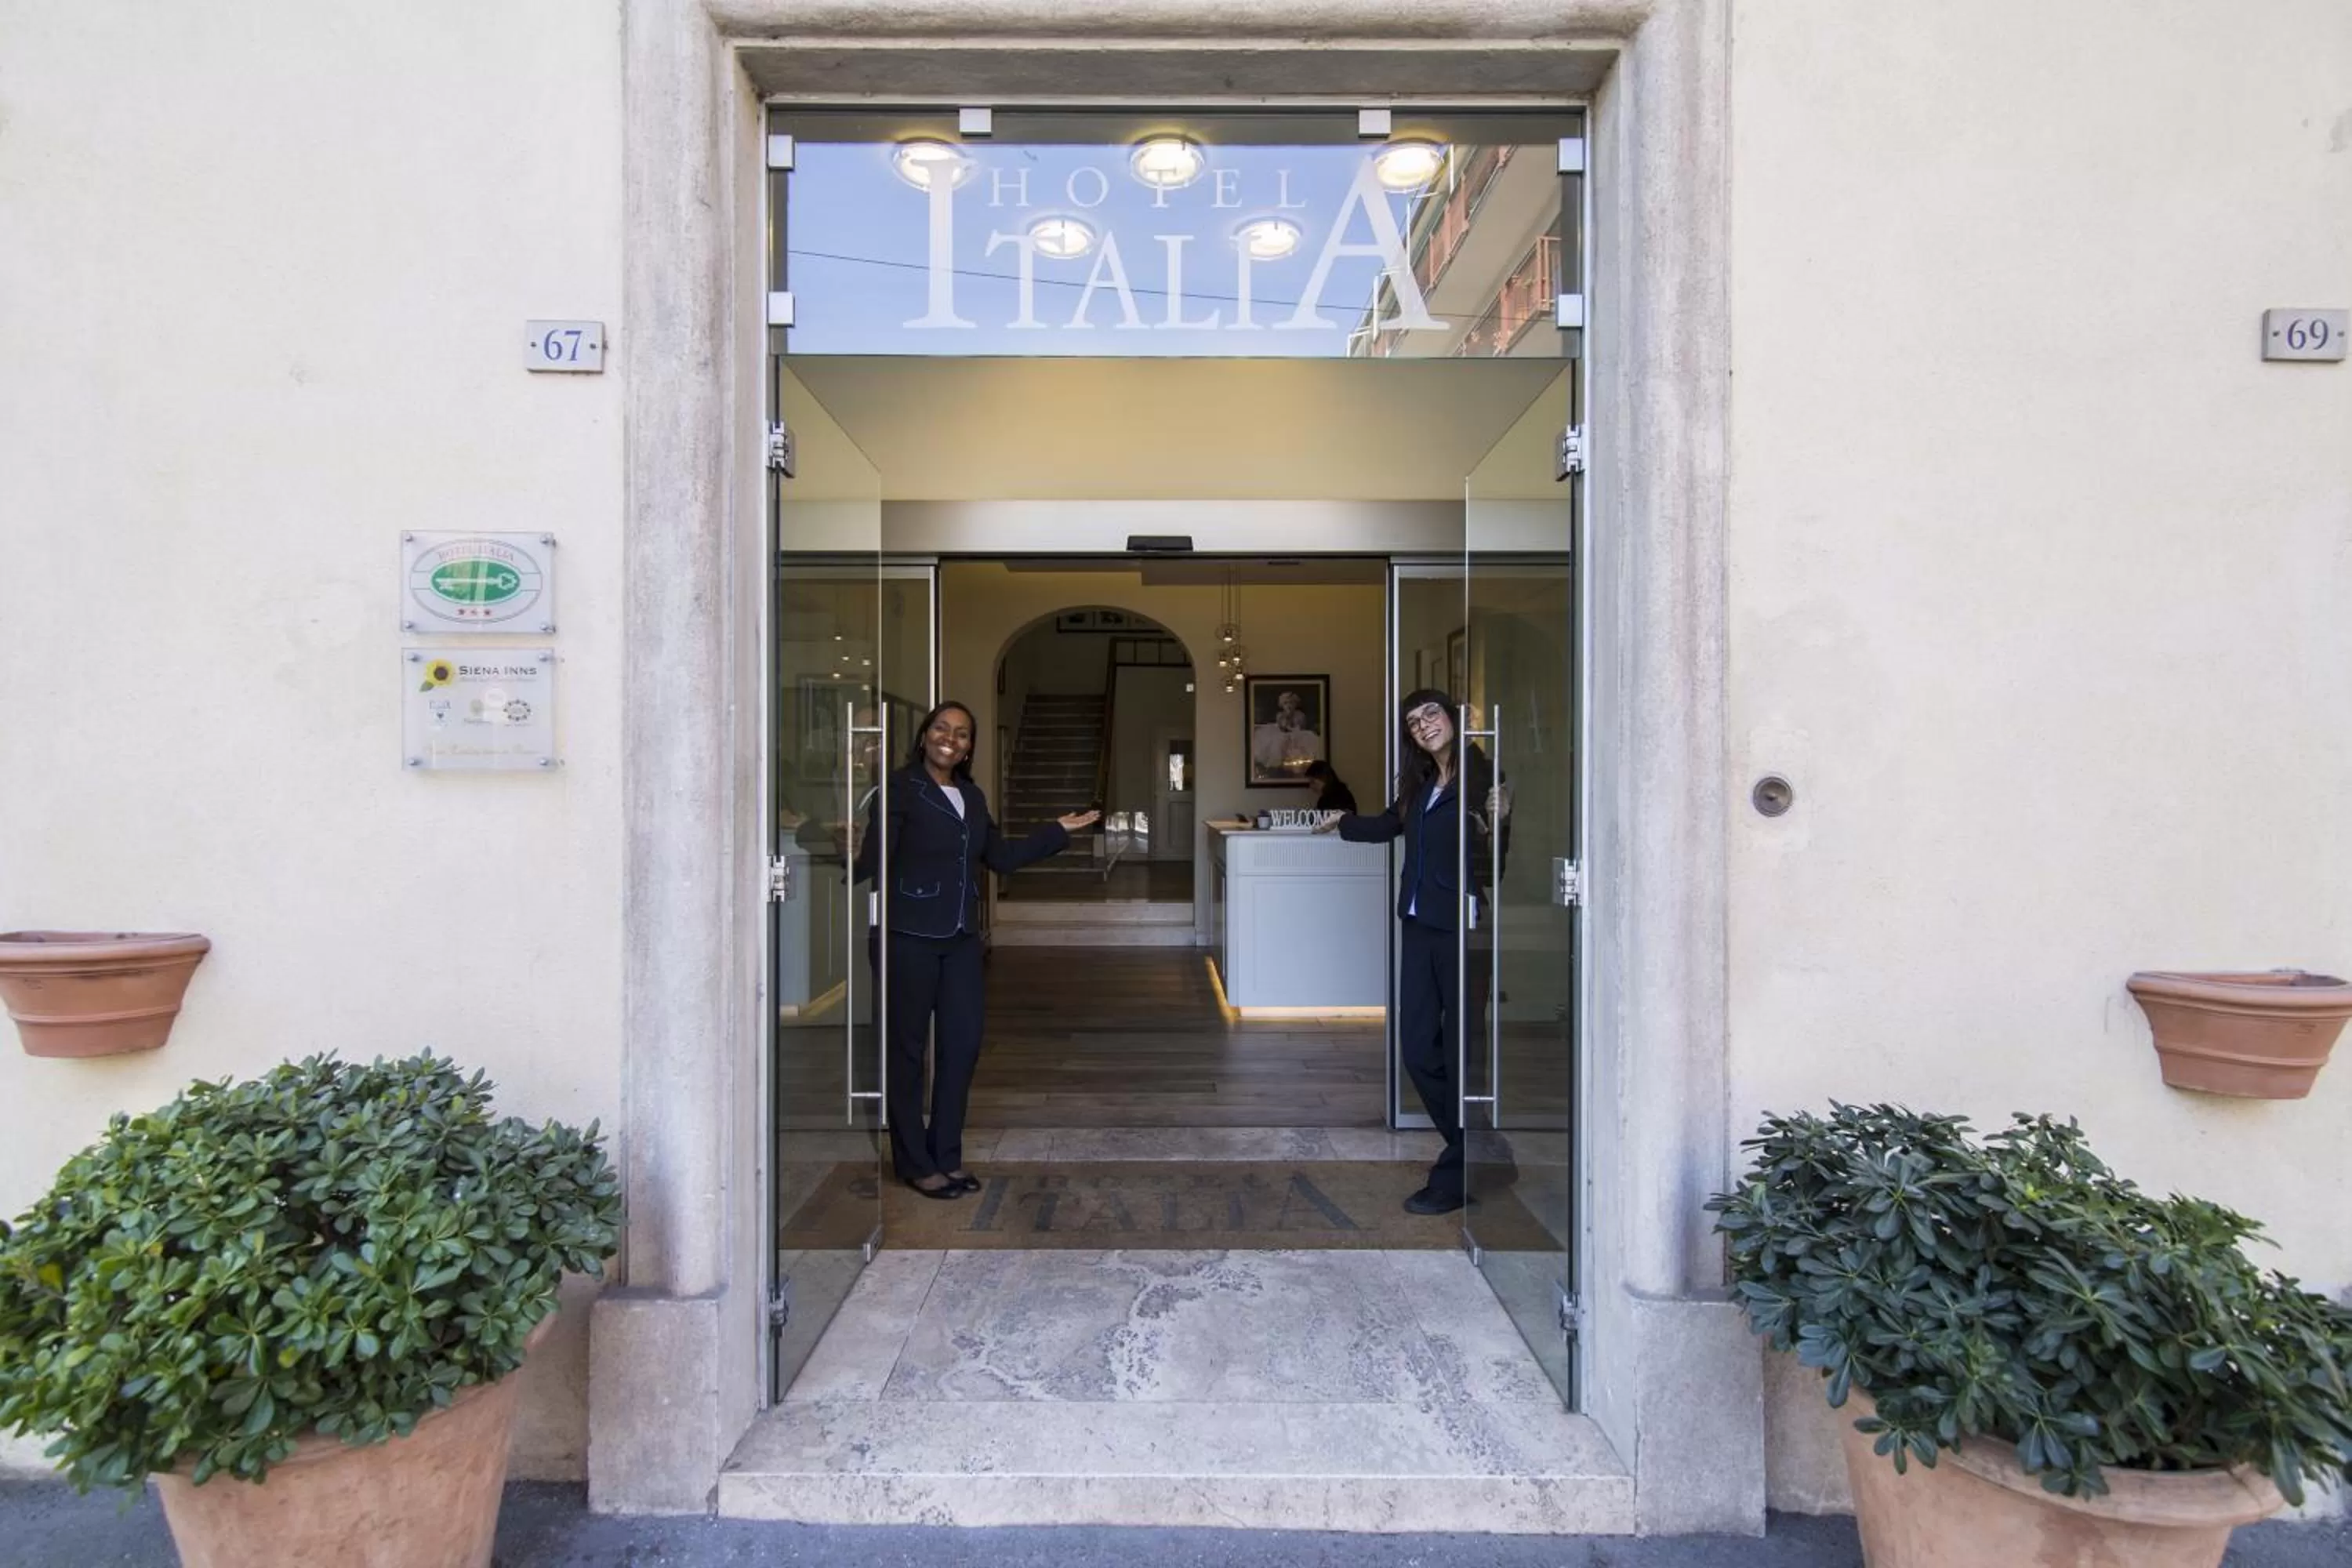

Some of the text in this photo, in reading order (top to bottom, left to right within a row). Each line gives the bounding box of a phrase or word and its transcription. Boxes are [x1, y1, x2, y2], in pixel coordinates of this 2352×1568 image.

[988, 166, 1307, 209] HOTEL
[902, 153, 1450, 330] ITALIA
[543, 328, 583, 361] 67
[2287, 318, 2328, 350] 69
[459, 665, 538, 675] SIENA INNS
